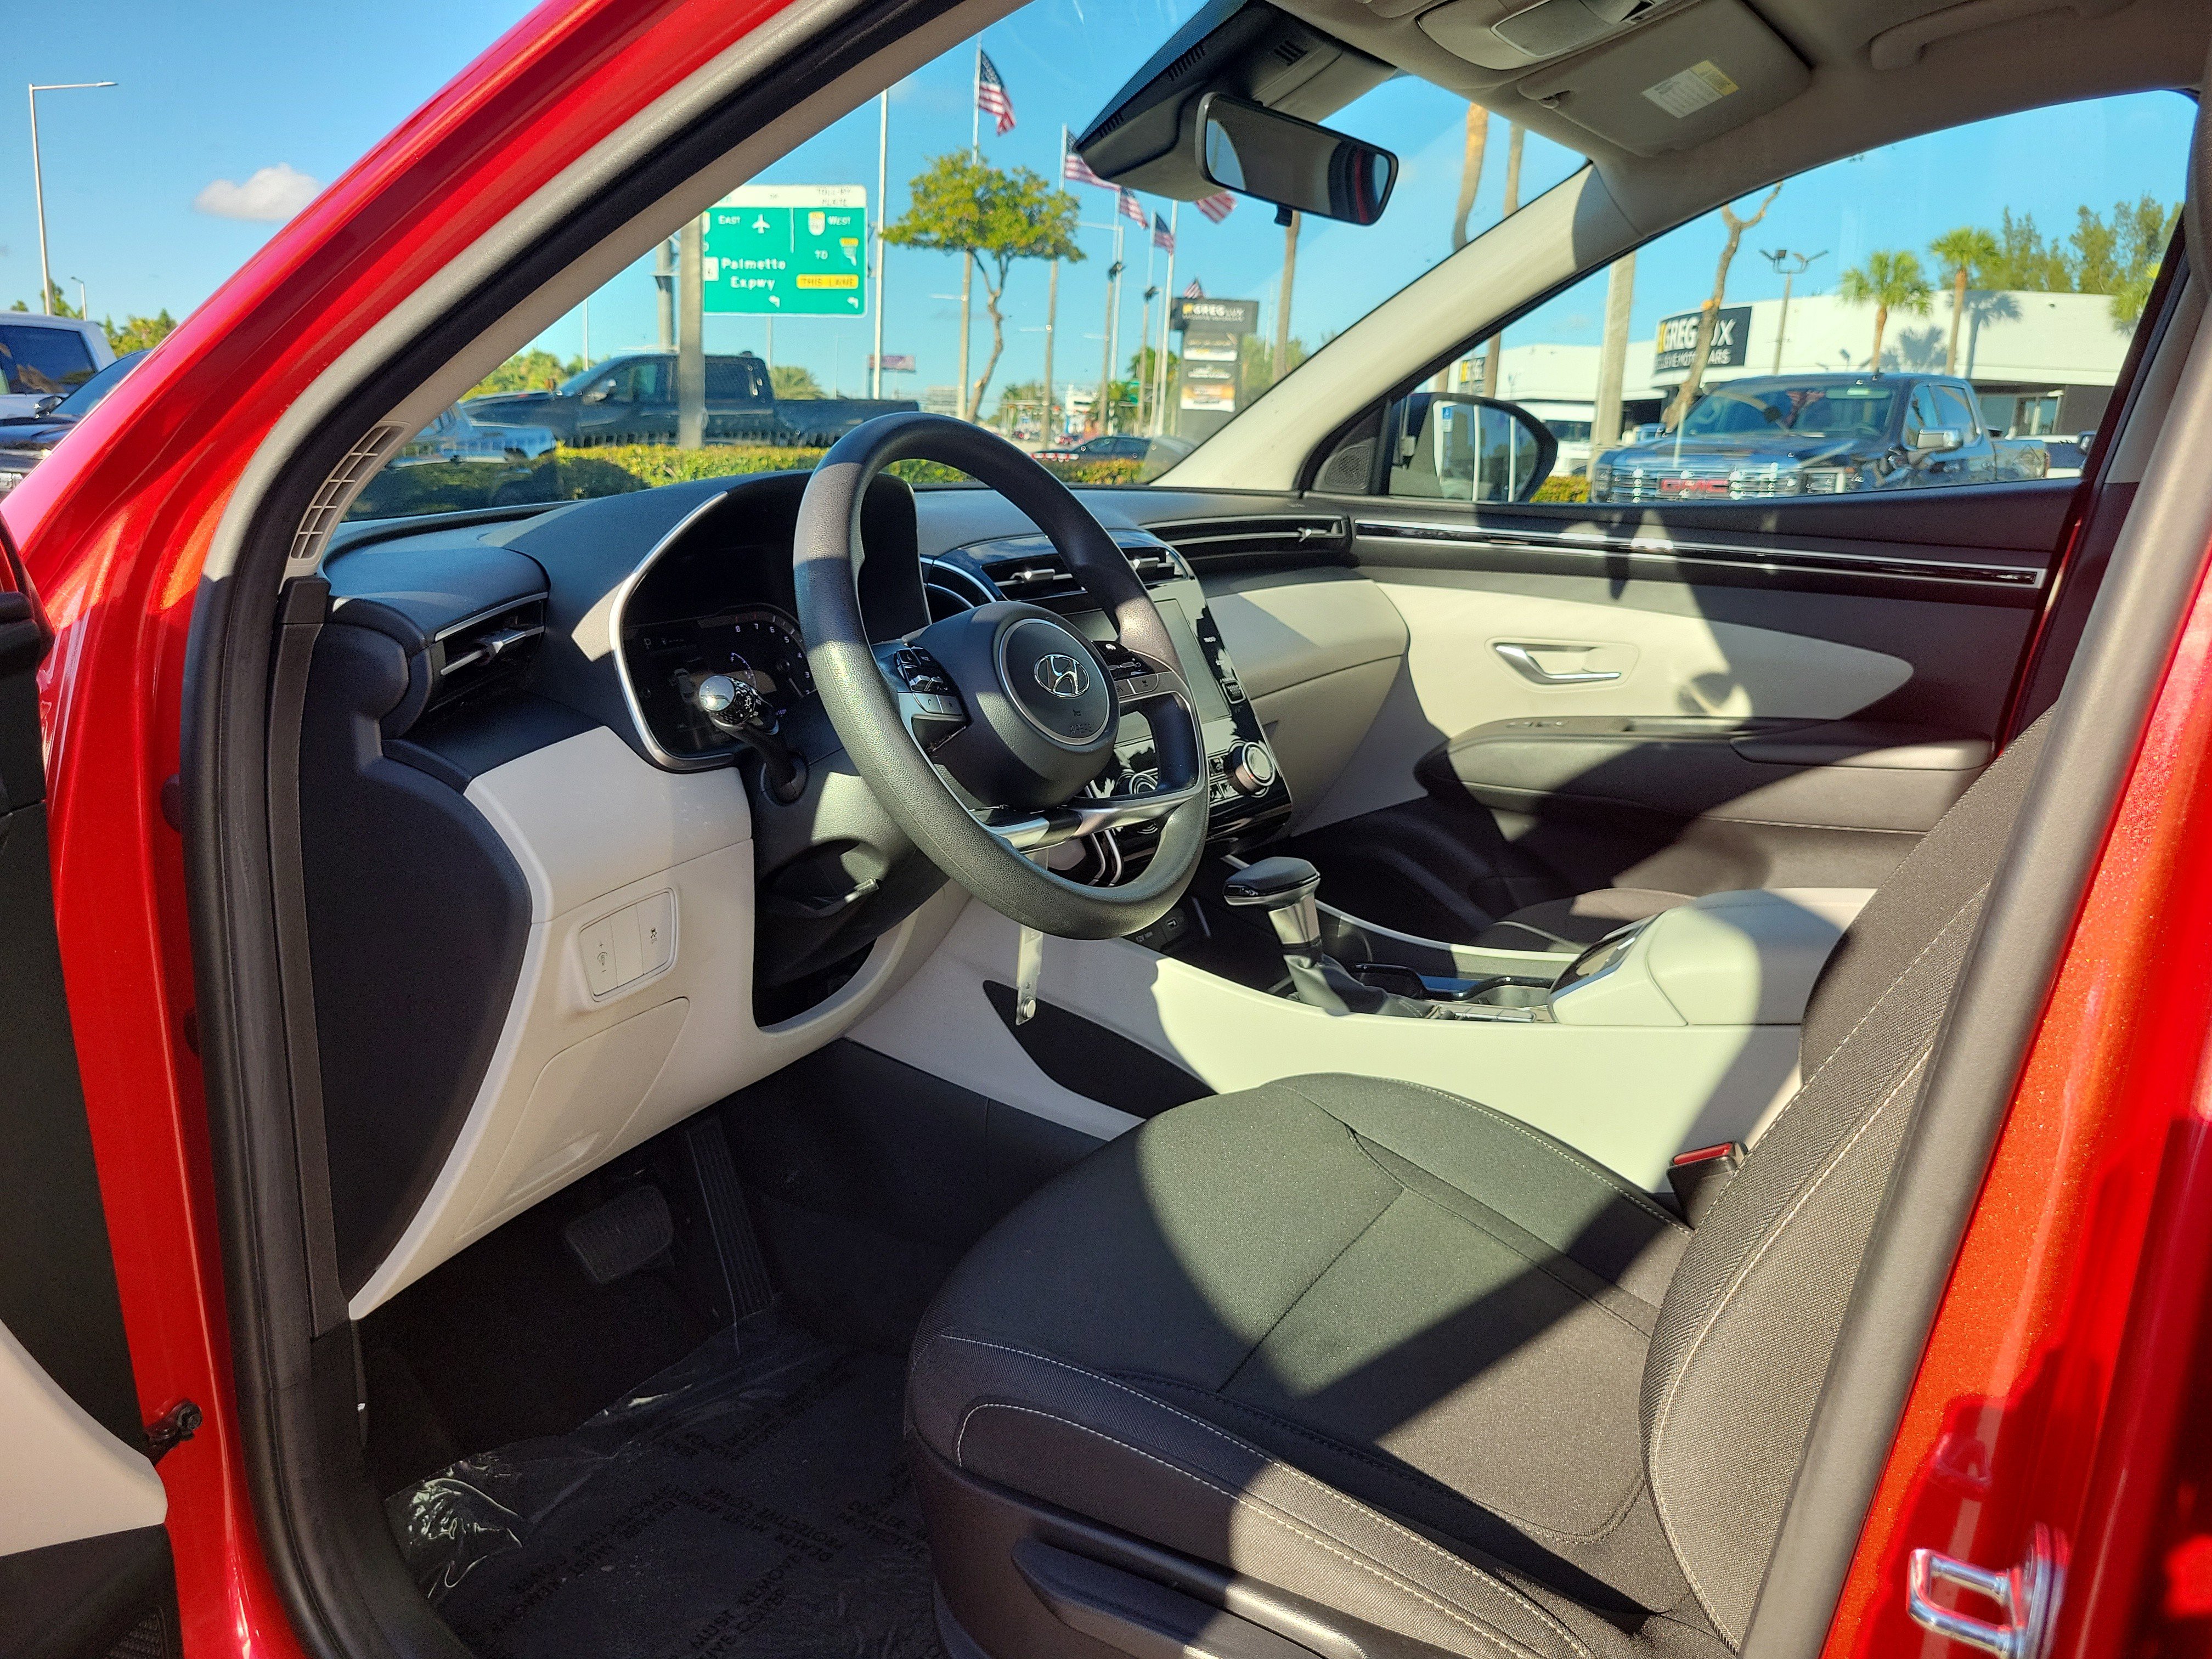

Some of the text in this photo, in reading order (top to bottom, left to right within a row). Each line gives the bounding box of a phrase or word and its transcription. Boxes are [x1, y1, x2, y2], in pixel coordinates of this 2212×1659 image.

[718, 215, 741, 224] EAST
[827, 215, 851, 225] WEST
[815, 250, 828, 260] TO
[721, 257, 786, 270] Palmetto
[730, 276, 775, 290] Expwy
[802, 278, 855, 286] THIS LANE
[1193, 303, 1226, 315] GREG
[1664, 317, 1700, 352] GREG
[1707, 348, 1731, 364] ARS
[1662, 478, 1728, 492] GMC
[644, 638, 652, 650] P
